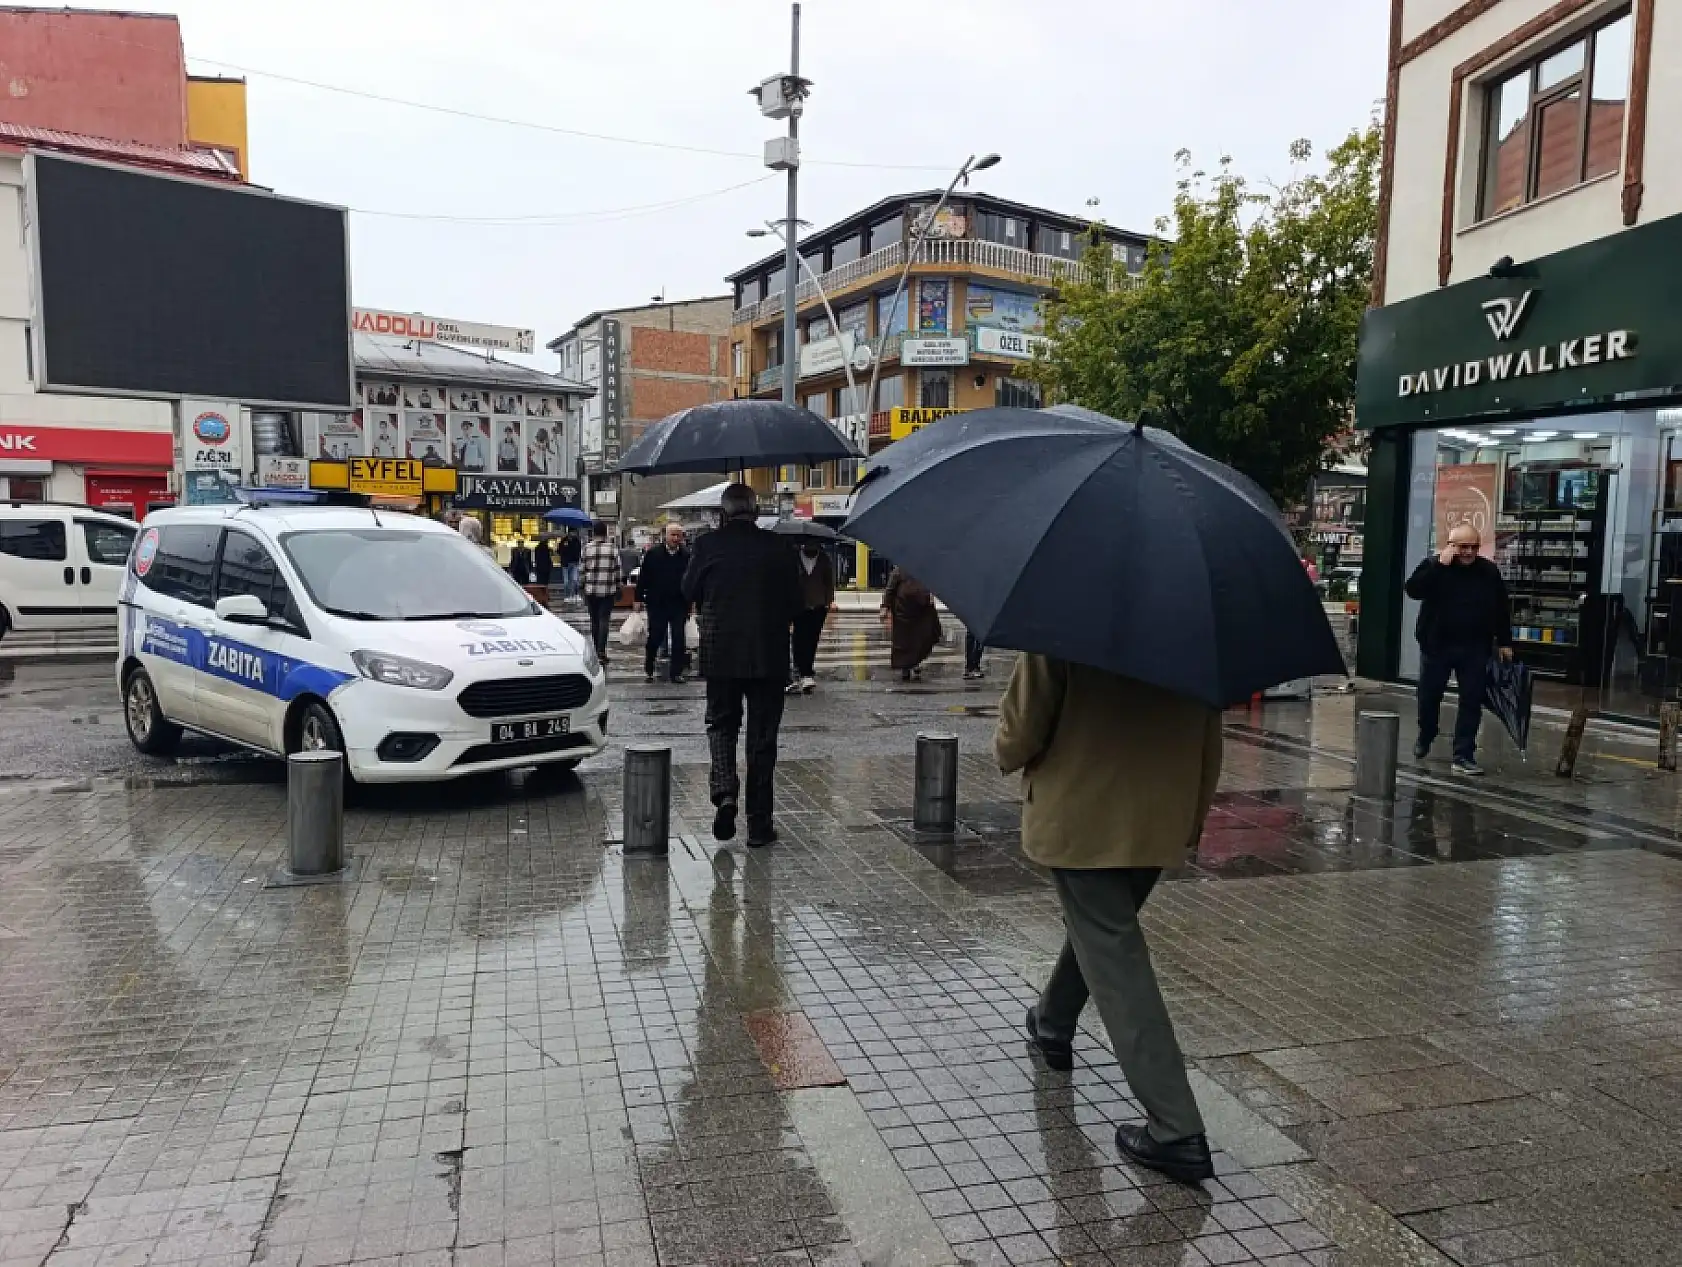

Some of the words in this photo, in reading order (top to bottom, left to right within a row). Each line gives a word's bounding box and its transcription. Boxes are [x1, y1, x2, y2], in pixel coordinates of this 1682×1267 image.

[1000, 331, 1023, 353] ÖZEL
[900, 409, 959, 423] BALK
[351, 459, 421, 480] EYFEL
[475, 479, 560, 496] KAYALAR
[459, 640, 558, 657] ZABITA
[208, 640, 264, 684] ZABITA
